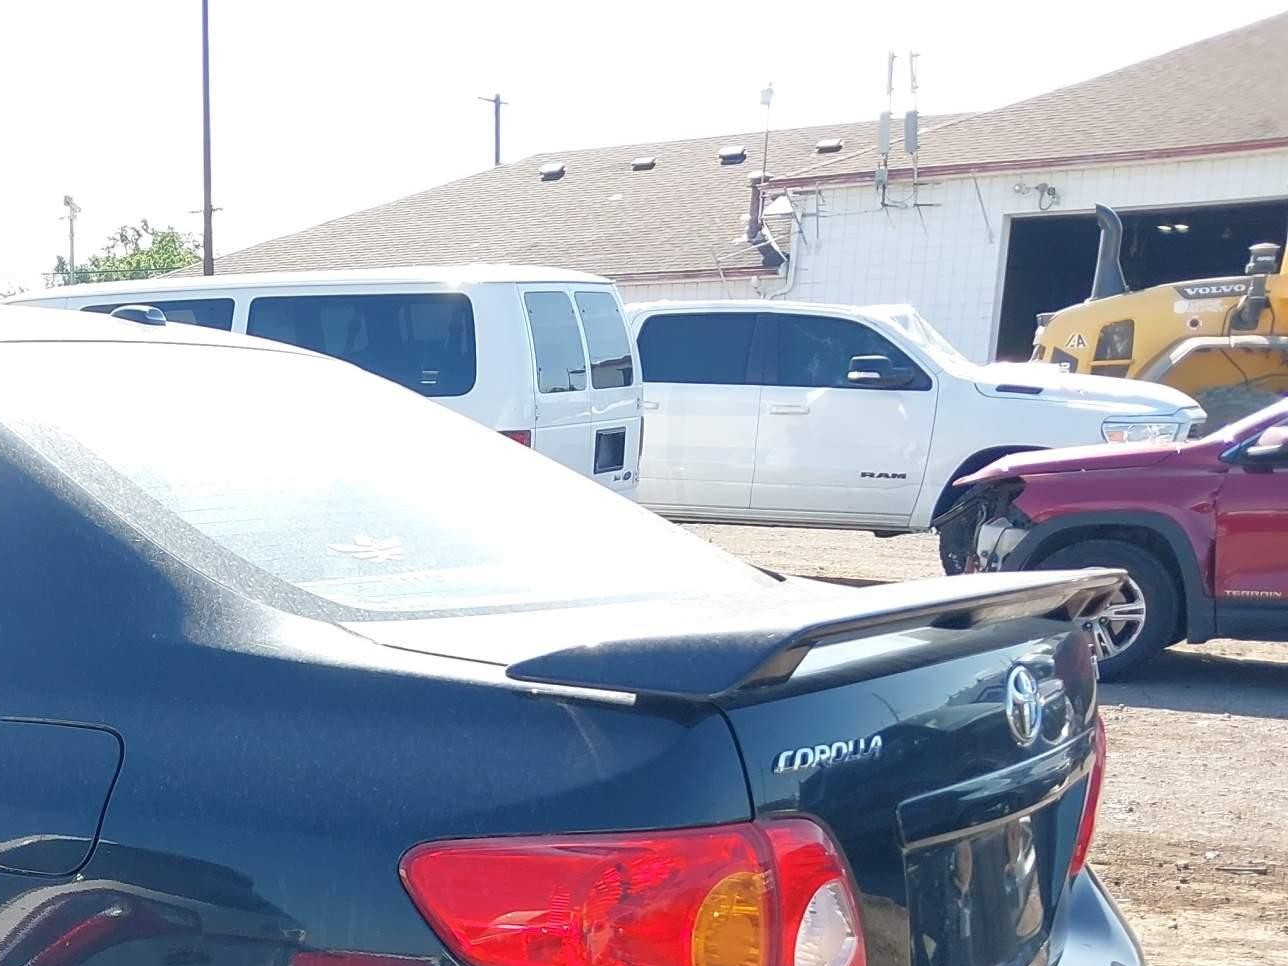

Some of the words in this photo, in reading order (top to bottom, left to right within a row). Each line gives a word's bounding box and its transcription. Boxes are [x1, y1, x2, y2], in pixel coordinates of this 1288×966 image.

[1184, 284, 1246, 296] VOLVO
[861, 471, 907, 480] RAM
[1224, 590, 1282, 598] TERRAIN
[774, 735, 882, 774] COROLLA
